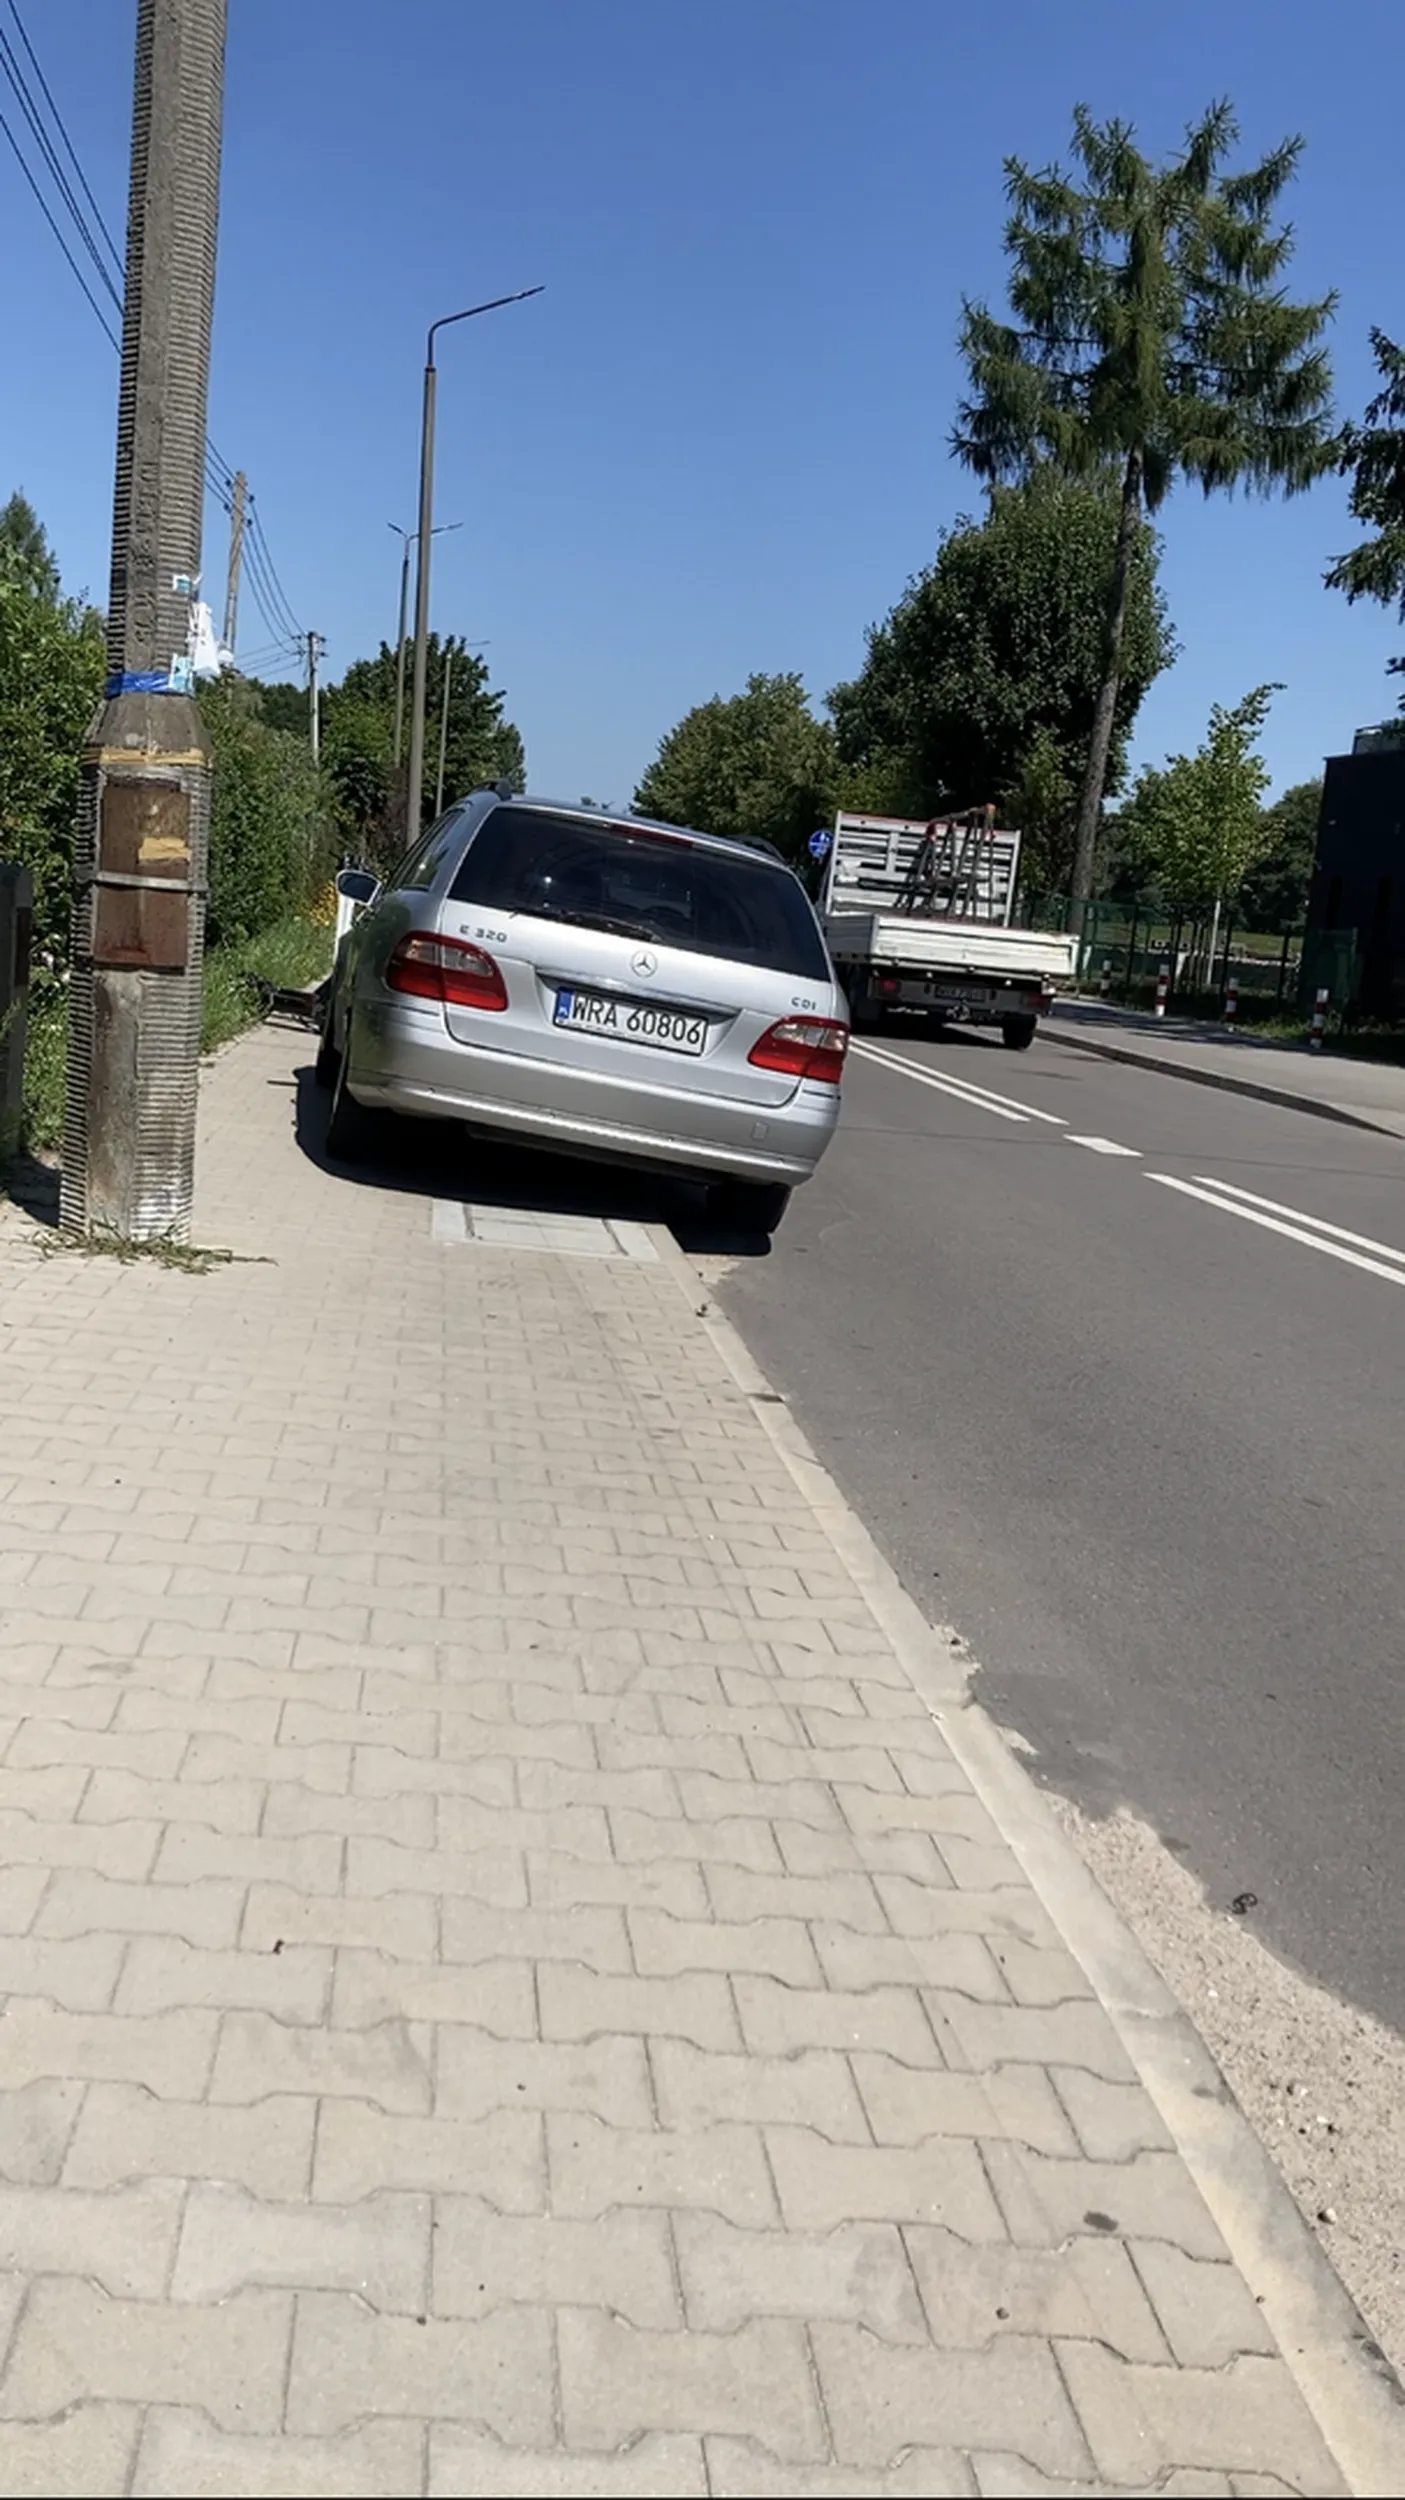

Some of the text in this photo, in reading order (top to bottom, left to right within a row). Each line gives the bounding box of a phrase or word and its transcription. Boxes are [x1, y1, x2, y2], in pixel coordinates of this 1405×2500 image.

[459, 924, 508, 943] E 320
[791, 996, 816, 1011] CDI
[572, 993, 617, 1028] WRA
[626, 1007, 702, 1045] 60806
